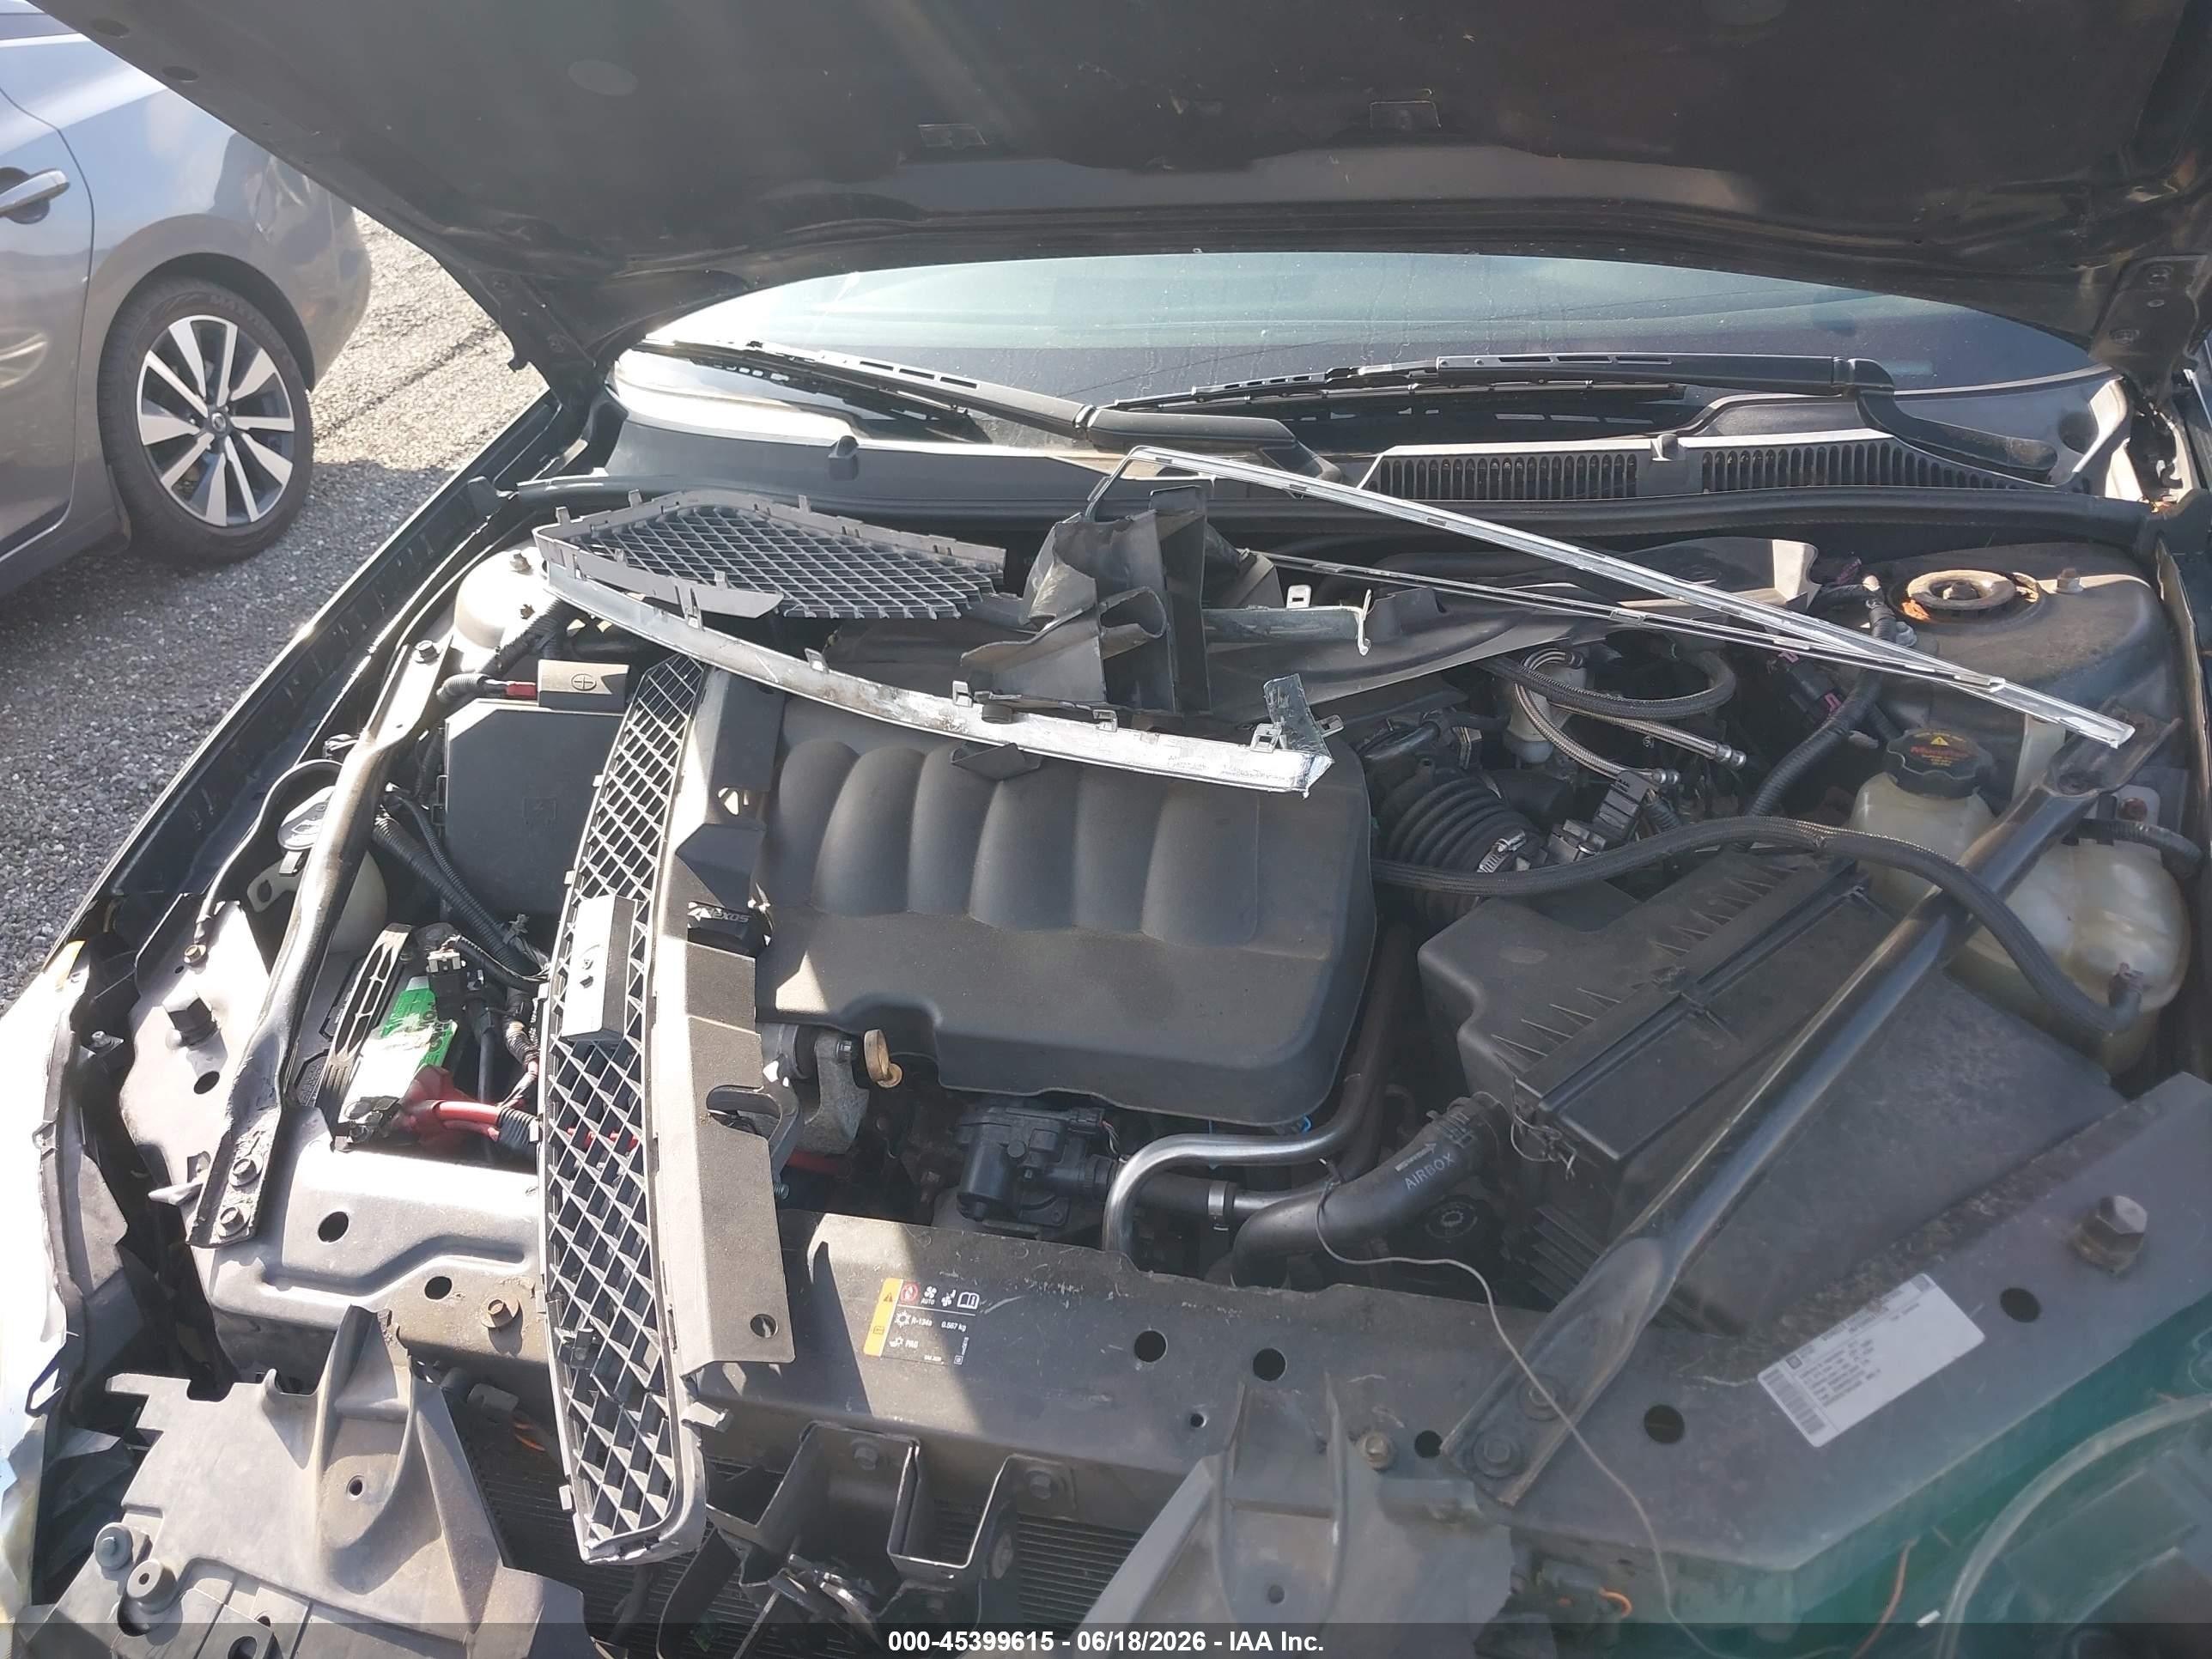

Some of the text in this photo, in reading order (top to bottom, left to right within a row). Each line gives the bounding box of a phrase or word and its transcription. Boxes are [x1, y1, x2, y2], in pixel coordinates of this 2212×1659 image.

[1404, 1152, 1455, 1189] AIRBOX
[911, 1316, 933, 1327] R-134a
[957, 1323, 967, 1333] kg
